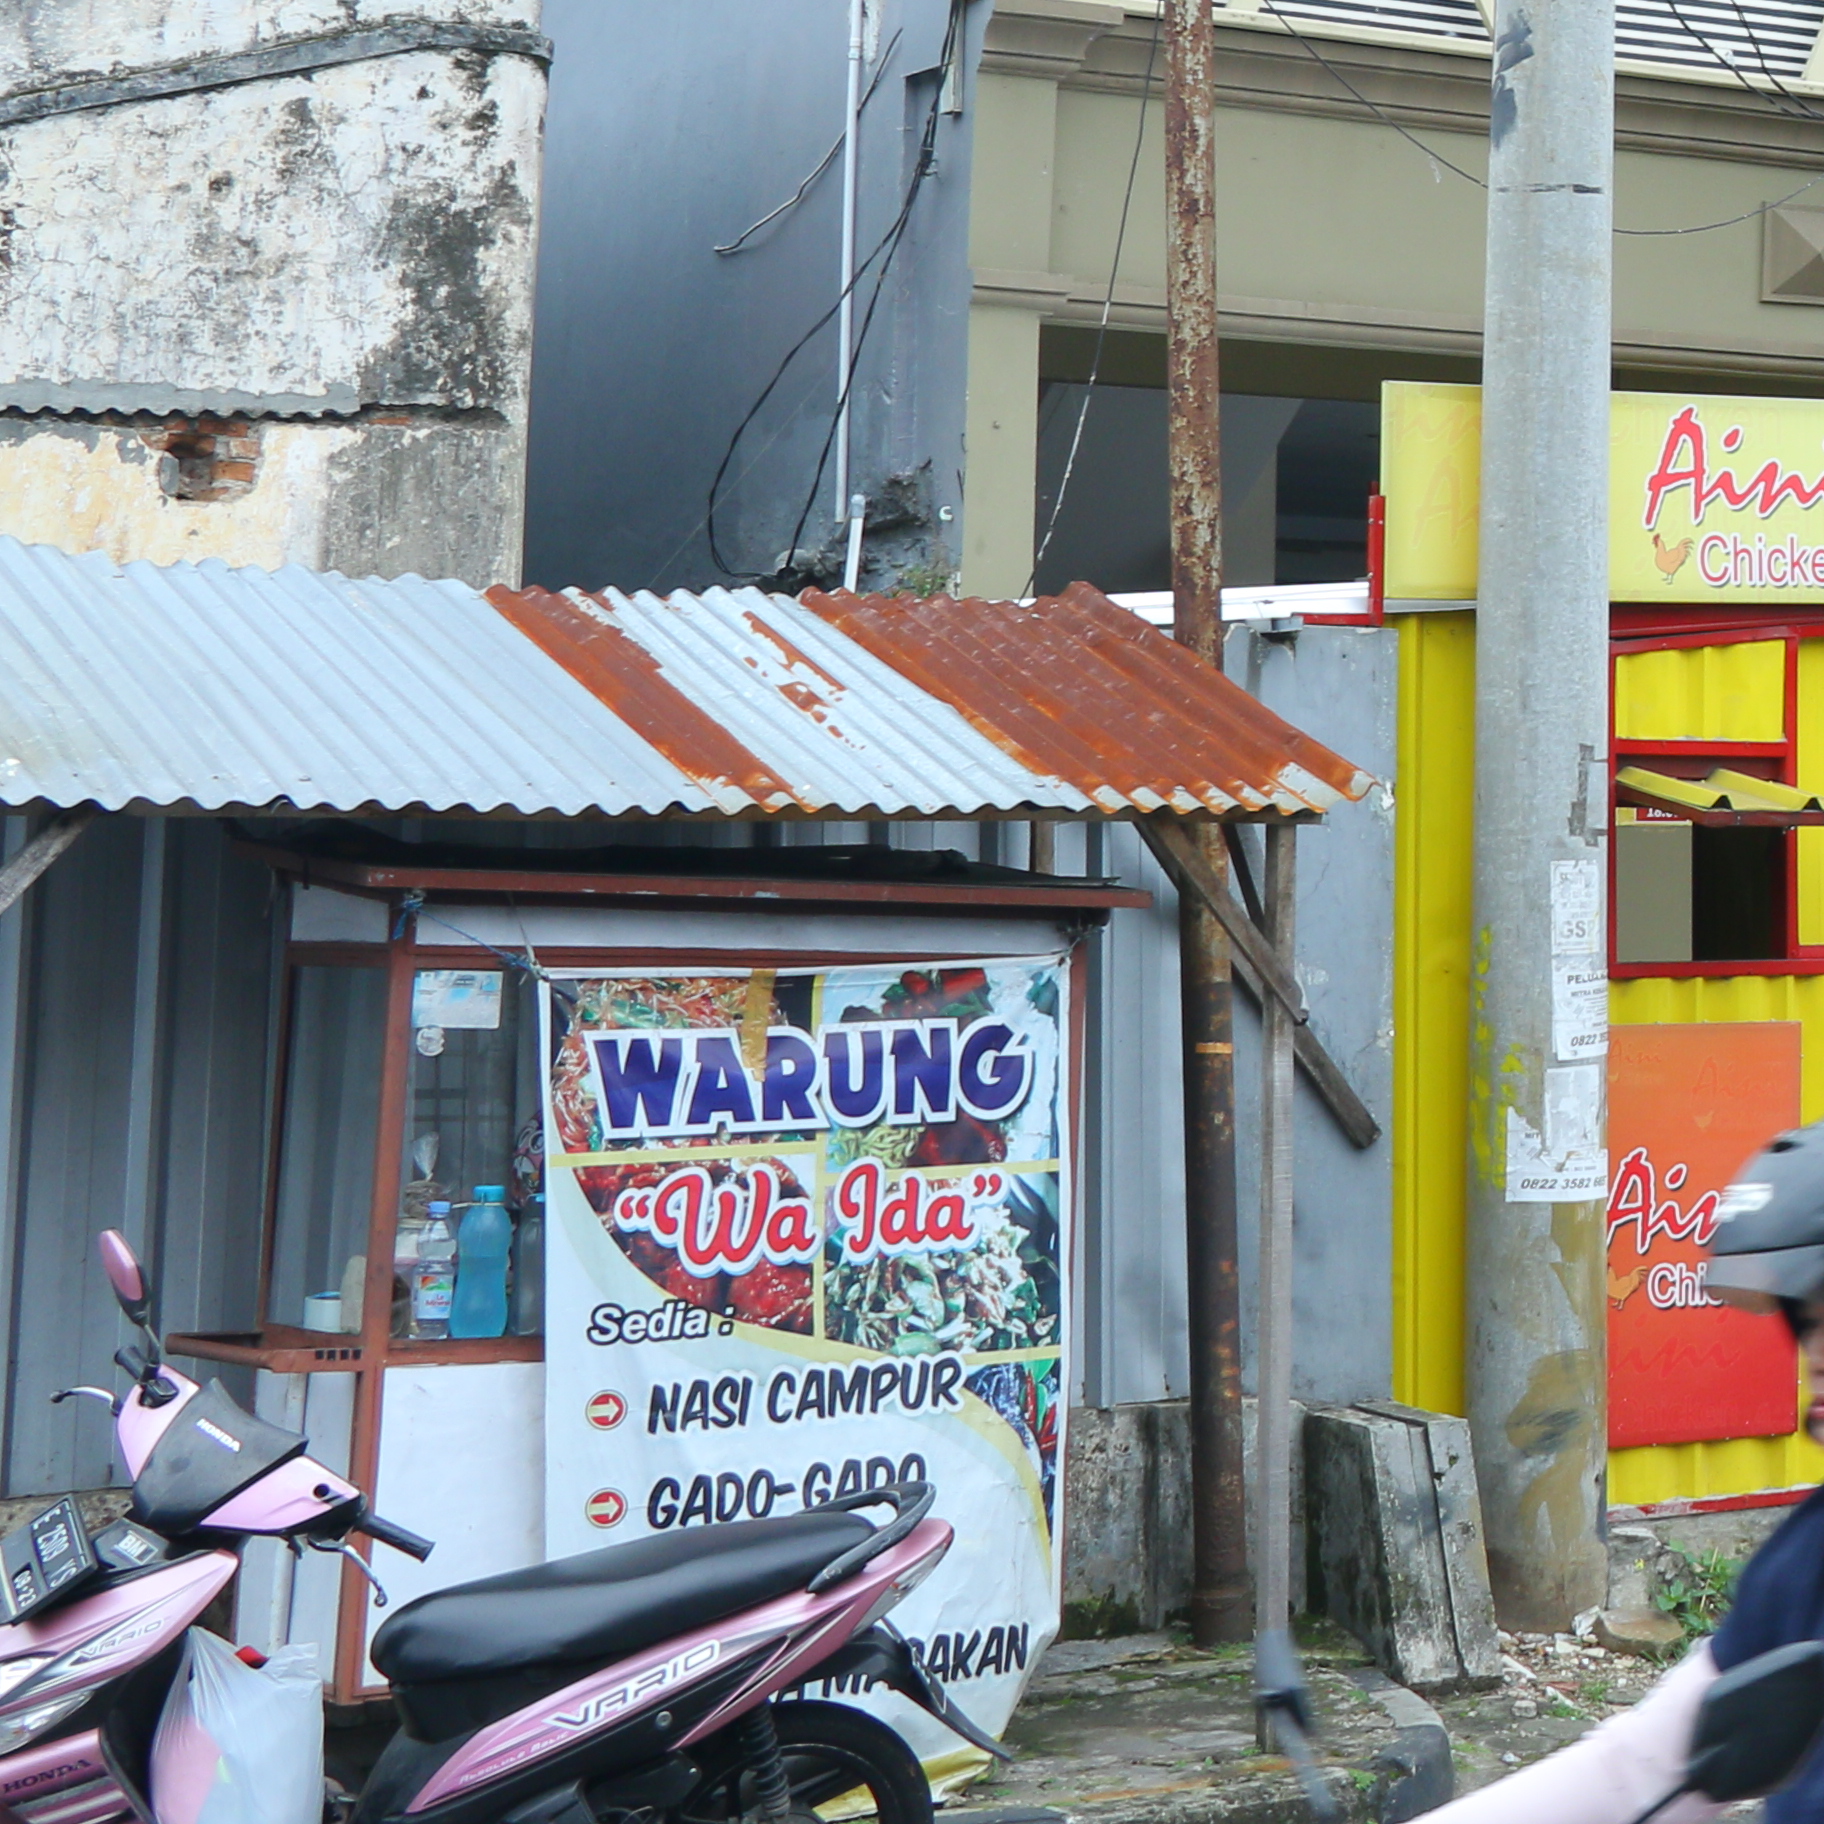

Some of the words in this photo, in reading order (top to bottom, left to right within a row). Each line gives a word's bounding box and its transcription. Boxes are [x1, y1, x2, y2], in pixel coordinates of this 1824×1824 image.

[590, 1020, 1028, 1131] WARUNG
[1521, 1178, 1557, 1189] 0822
[1562, 1178, 1591, 1189] 3582
[586, 1299, 711, 1346] Sedia
[647, 1376, 752, 1434] NASI
[767, 1357, 963, 1423] CAMPUR
[196, 1416, 241, 1453] HONDA
[543, 1639, 721, 1731] VARIO
[3, 1759, 92, 1793] HONDA
